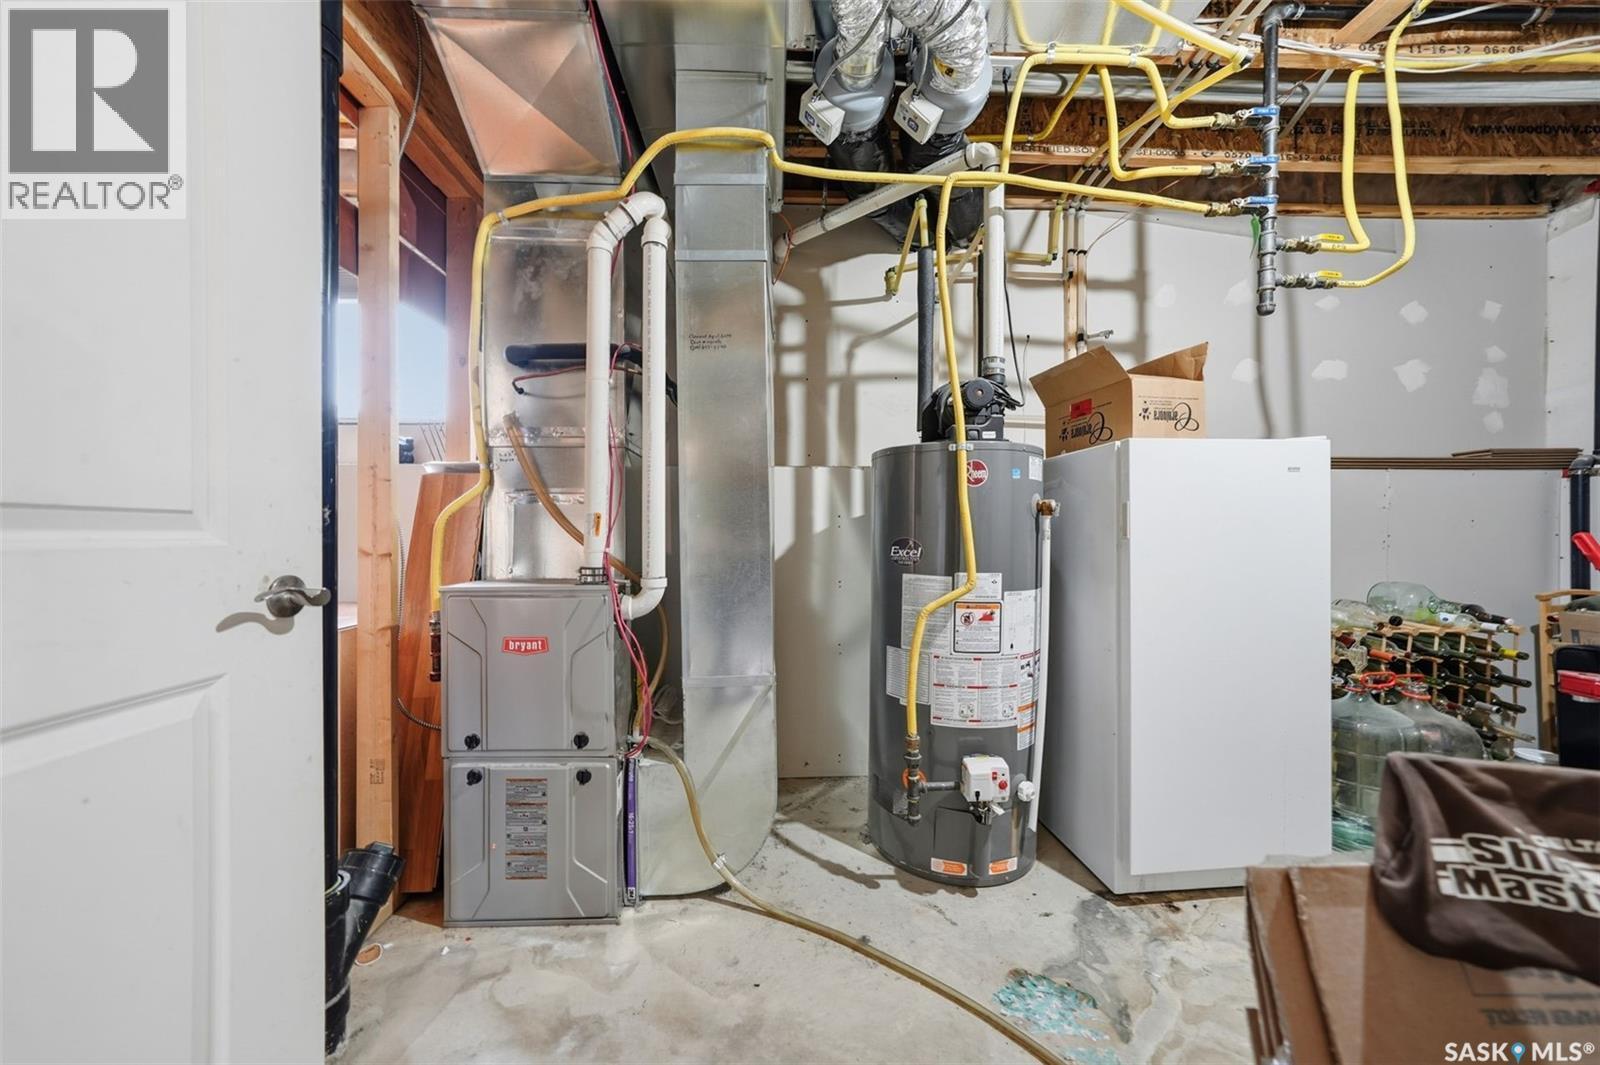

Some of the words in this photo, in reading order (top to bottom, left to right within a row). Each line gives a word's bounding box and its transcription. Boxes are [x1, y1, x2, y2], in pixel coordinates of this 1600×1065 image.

[1407, 45, 1471, 54] 11-16-12
[1087, 112, 1126, 126] Trs
[890, 546, 922, 559] Excel
[508, 640, 543, 652] bryant
